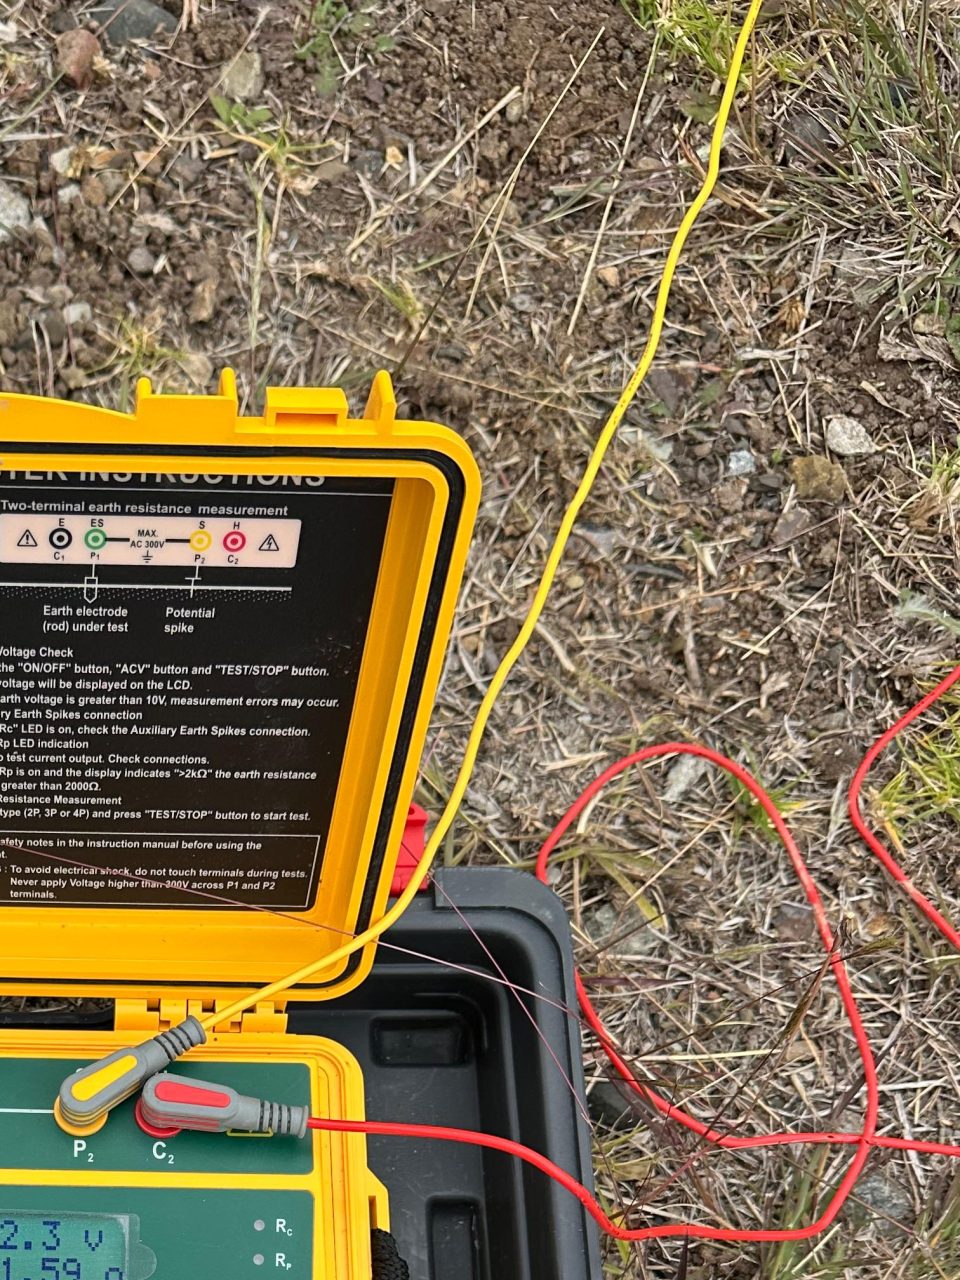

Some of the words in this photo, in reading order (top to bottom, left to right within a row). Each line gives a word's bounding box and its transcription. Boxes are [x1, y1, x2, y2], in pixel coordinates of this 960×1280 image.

[0, 499, 85, 512] Two-terminal
[88, 502, 121, 512] earth
[125, 502, 191, 514] resistance
[197, 505, 288, 516] measurement
[58, 518, 65, 527] E
[90, 519, 104, 528] ES
[198, 521, 206, 529] S
[233, 521, 240, 530] H
[130, 540, 142, 548] AC
[144, 540, 165, 549] 300V
[43, 604, 73, 616] Earth
[75, 605, 128, 617] electrode
[165, 606, 215, 618] Potential
[42, 620, 69, 634] (rod)
[72, 620, 105, 632] under
[107, 621, 128, 632] test
[163, 622, 194, 635] spike
[39, 646, 73, 658] Check
[74, 663, 112, 675] button,
[153, 663, 188, 674] button
[191, 664, 212, 675] and
[291, 665, 329, 676] button.
[37, 678, 56, 689] will
[59, 678, 72, 689] be
[75, 678, 127, 692] displayed
[129, 681, 144, 690] on
[146, 679, 164, 690] the
[166, 679, 192, 690] LCD.
[23, 693, 63, 706] voltage
[66, 694, 75, 704] is
[78, 695, 117, 707] greater
[118, 694, 142, 705] than
[146, 695, 167, 706] 10V,
[170, 696, 243, 706] measurement
[245, 698, 278, 706] errors
[280, 698, 304, 709] may
[306, 698, 339, 707] occur.
[14, 708, 42, 719] Earth
[44, 709, 80, 721] Spikes
[83, 709, 142, 720] connection
[13, 738, 35, 748] LED
[37, 738, 89, 749] indication
[53, 794, 122, 805] Measurement
